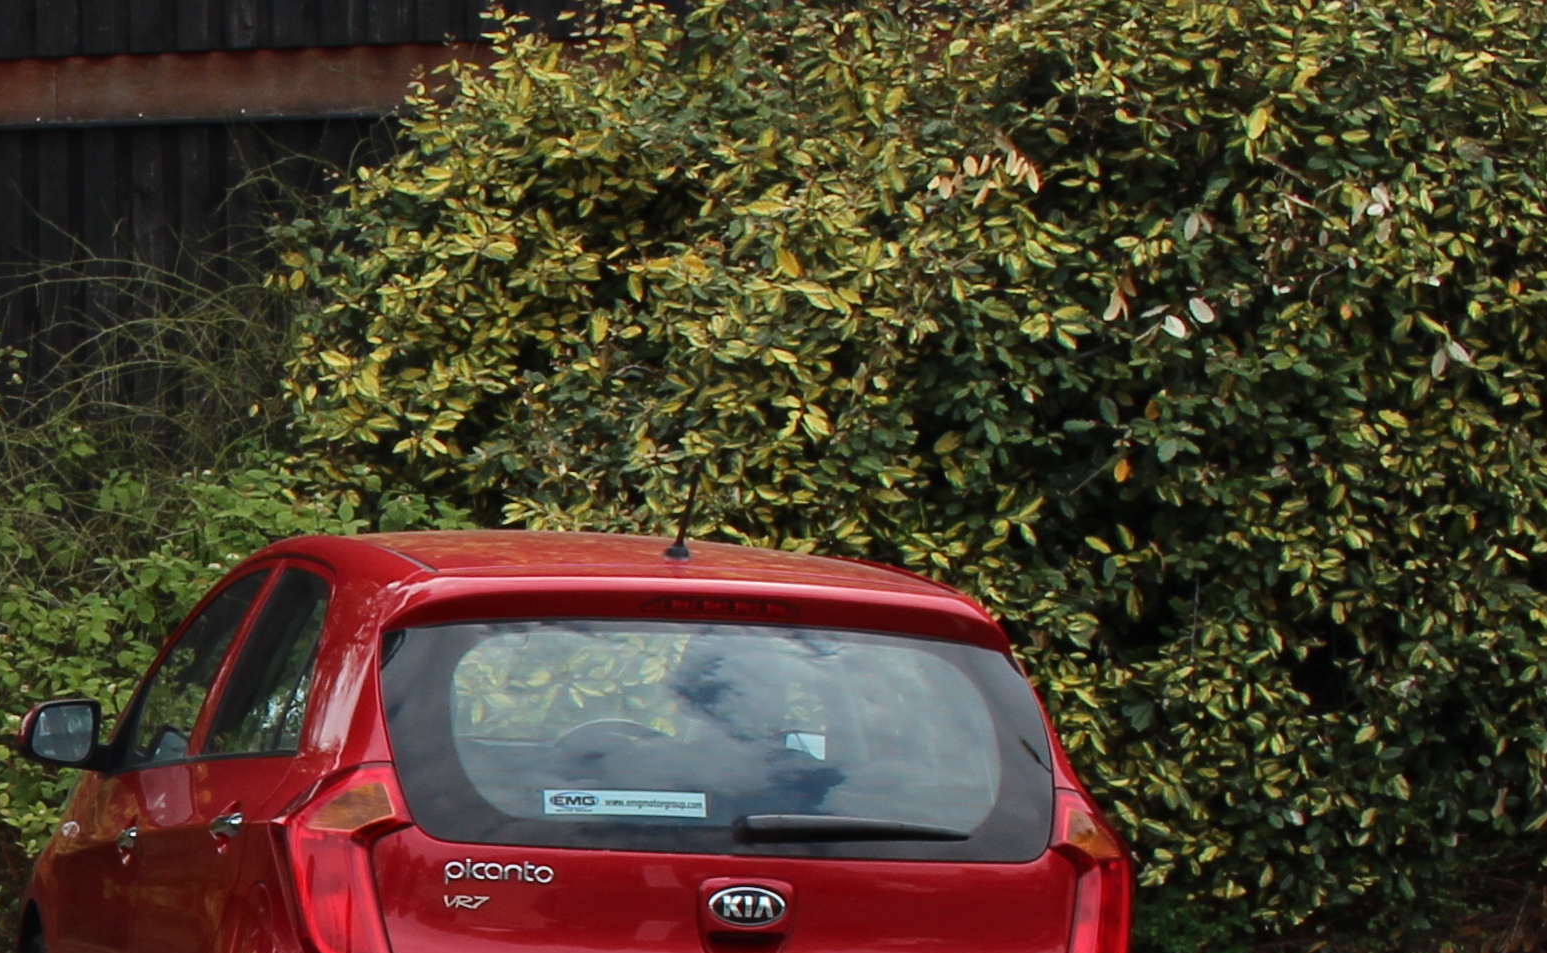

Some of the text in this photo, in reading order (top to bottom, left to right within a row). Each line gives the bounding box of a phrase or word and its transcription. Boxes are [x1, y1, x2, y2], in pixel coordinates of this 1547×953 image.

[553, 796, 595, 806] EMG
[444, 858, 554, 884] picanto
[443, 894, 490, 909] VR7
[722, 895, 774, 918] KIA
